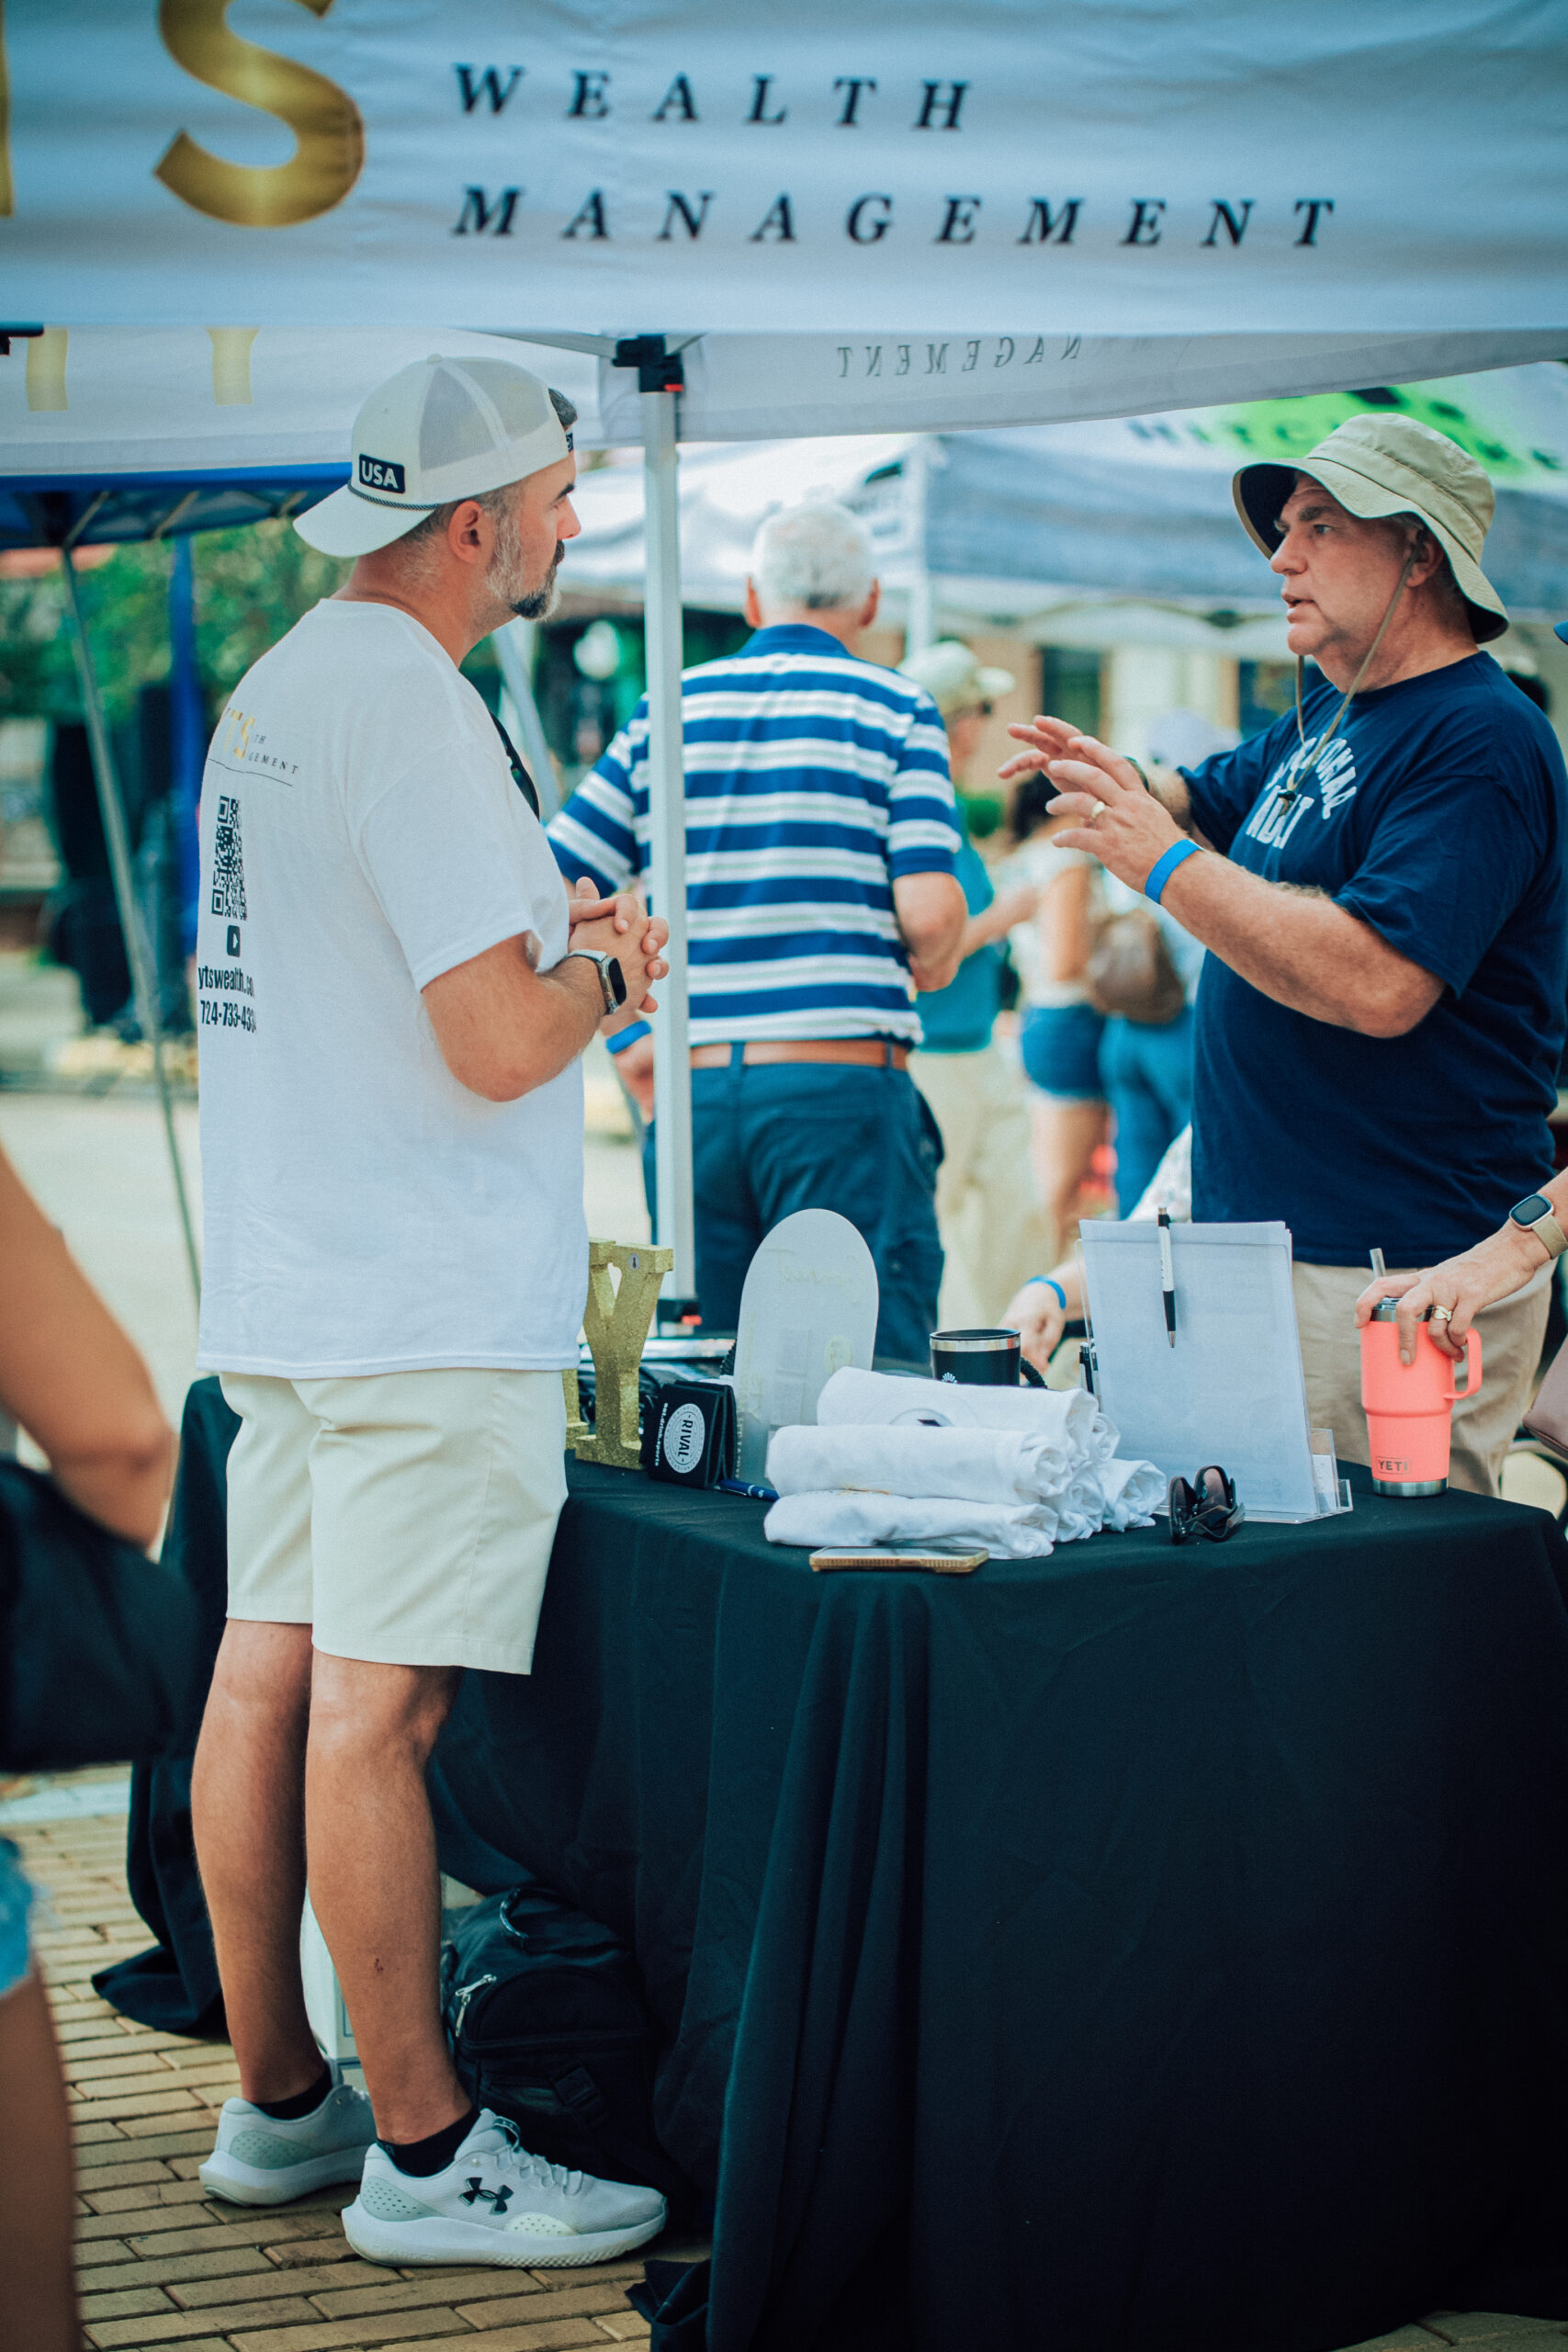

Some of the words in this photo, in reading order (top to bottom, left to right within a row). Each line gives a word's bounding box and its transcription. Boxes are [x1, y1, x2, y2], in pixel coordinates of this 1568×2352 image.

[454, 62, 972, 131] WEALTH
[450, 184, 1337, 248] MANAGEMENT
[361, 459, 399, 490] USA
[678, 1419, 694, 1457] RIVAL
[1378, 1459, 1408, 1472] YETI
